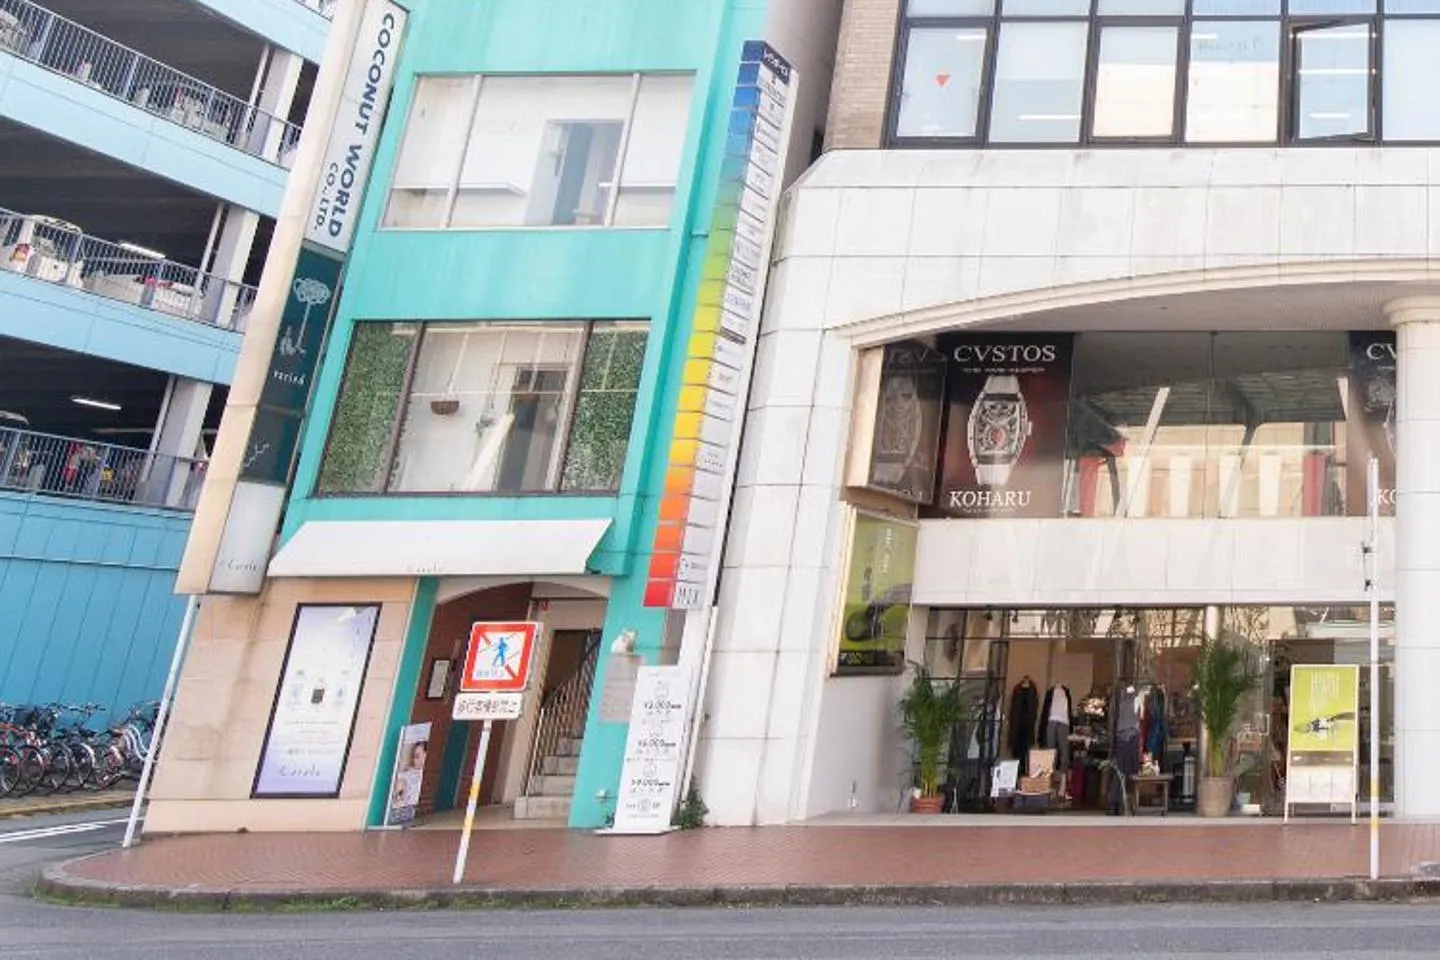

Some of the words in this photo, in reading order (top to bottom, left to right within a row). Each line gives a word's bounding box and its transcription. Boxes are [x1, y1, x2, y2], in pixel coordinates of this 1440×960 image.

[355, 13, 395, 135] COCONUT
[328, 145, 362, 236] WORLD
[953, 344, 1056, 362] CVSTOS
[950, 490, 1032, 507] KOHARU
